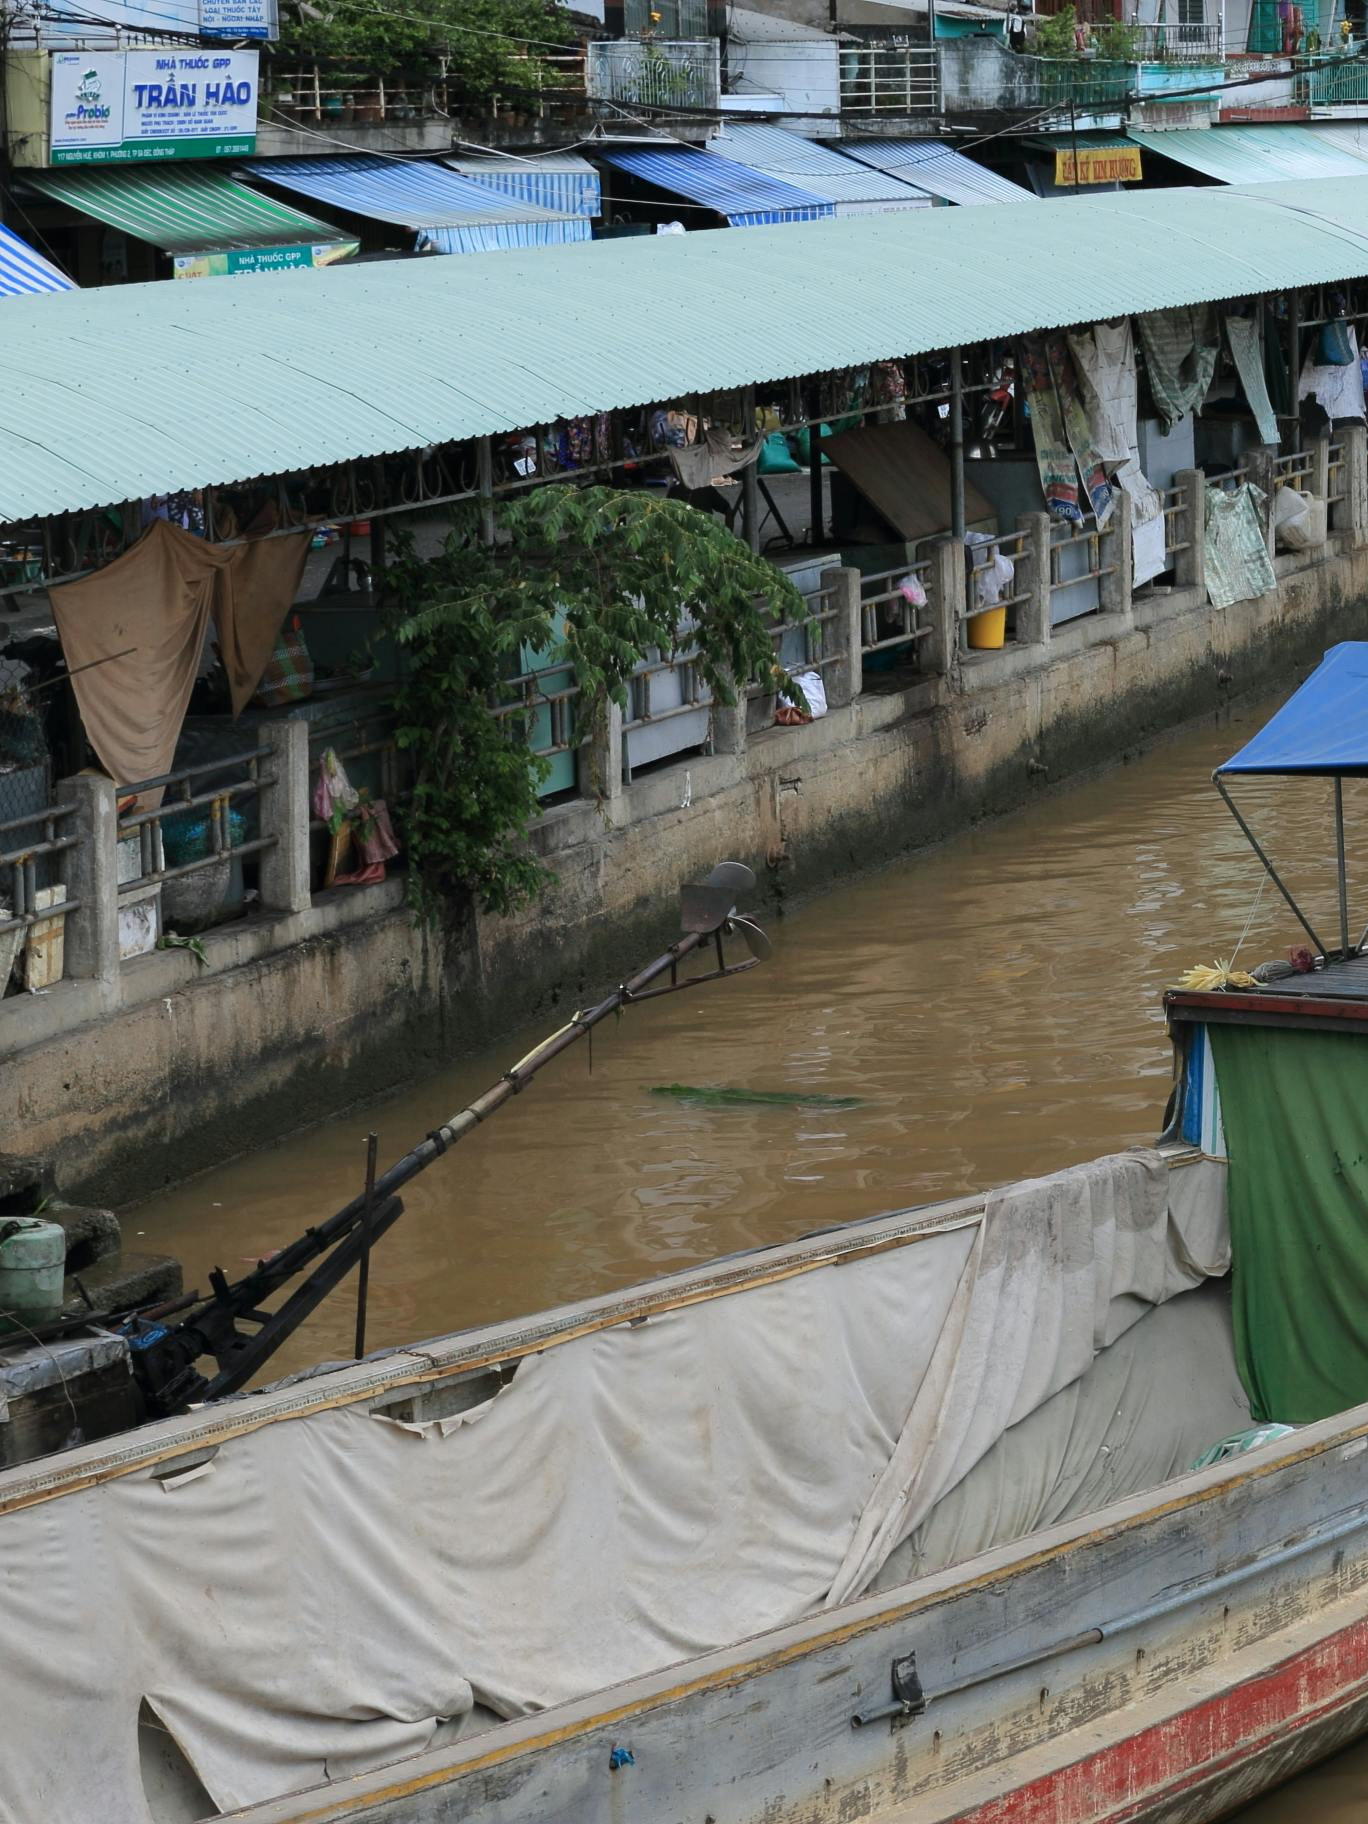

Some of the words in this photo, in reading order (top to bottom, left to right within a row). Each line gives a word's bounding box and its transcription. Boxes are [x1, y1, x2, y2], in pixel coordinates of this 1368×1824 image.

[179, 55, 209, 69] THUỐC
[212, 58, 231, 69] GPP
[257, 252, 283, 263] THUỐC
[285, 252, 301, 260] GPP
